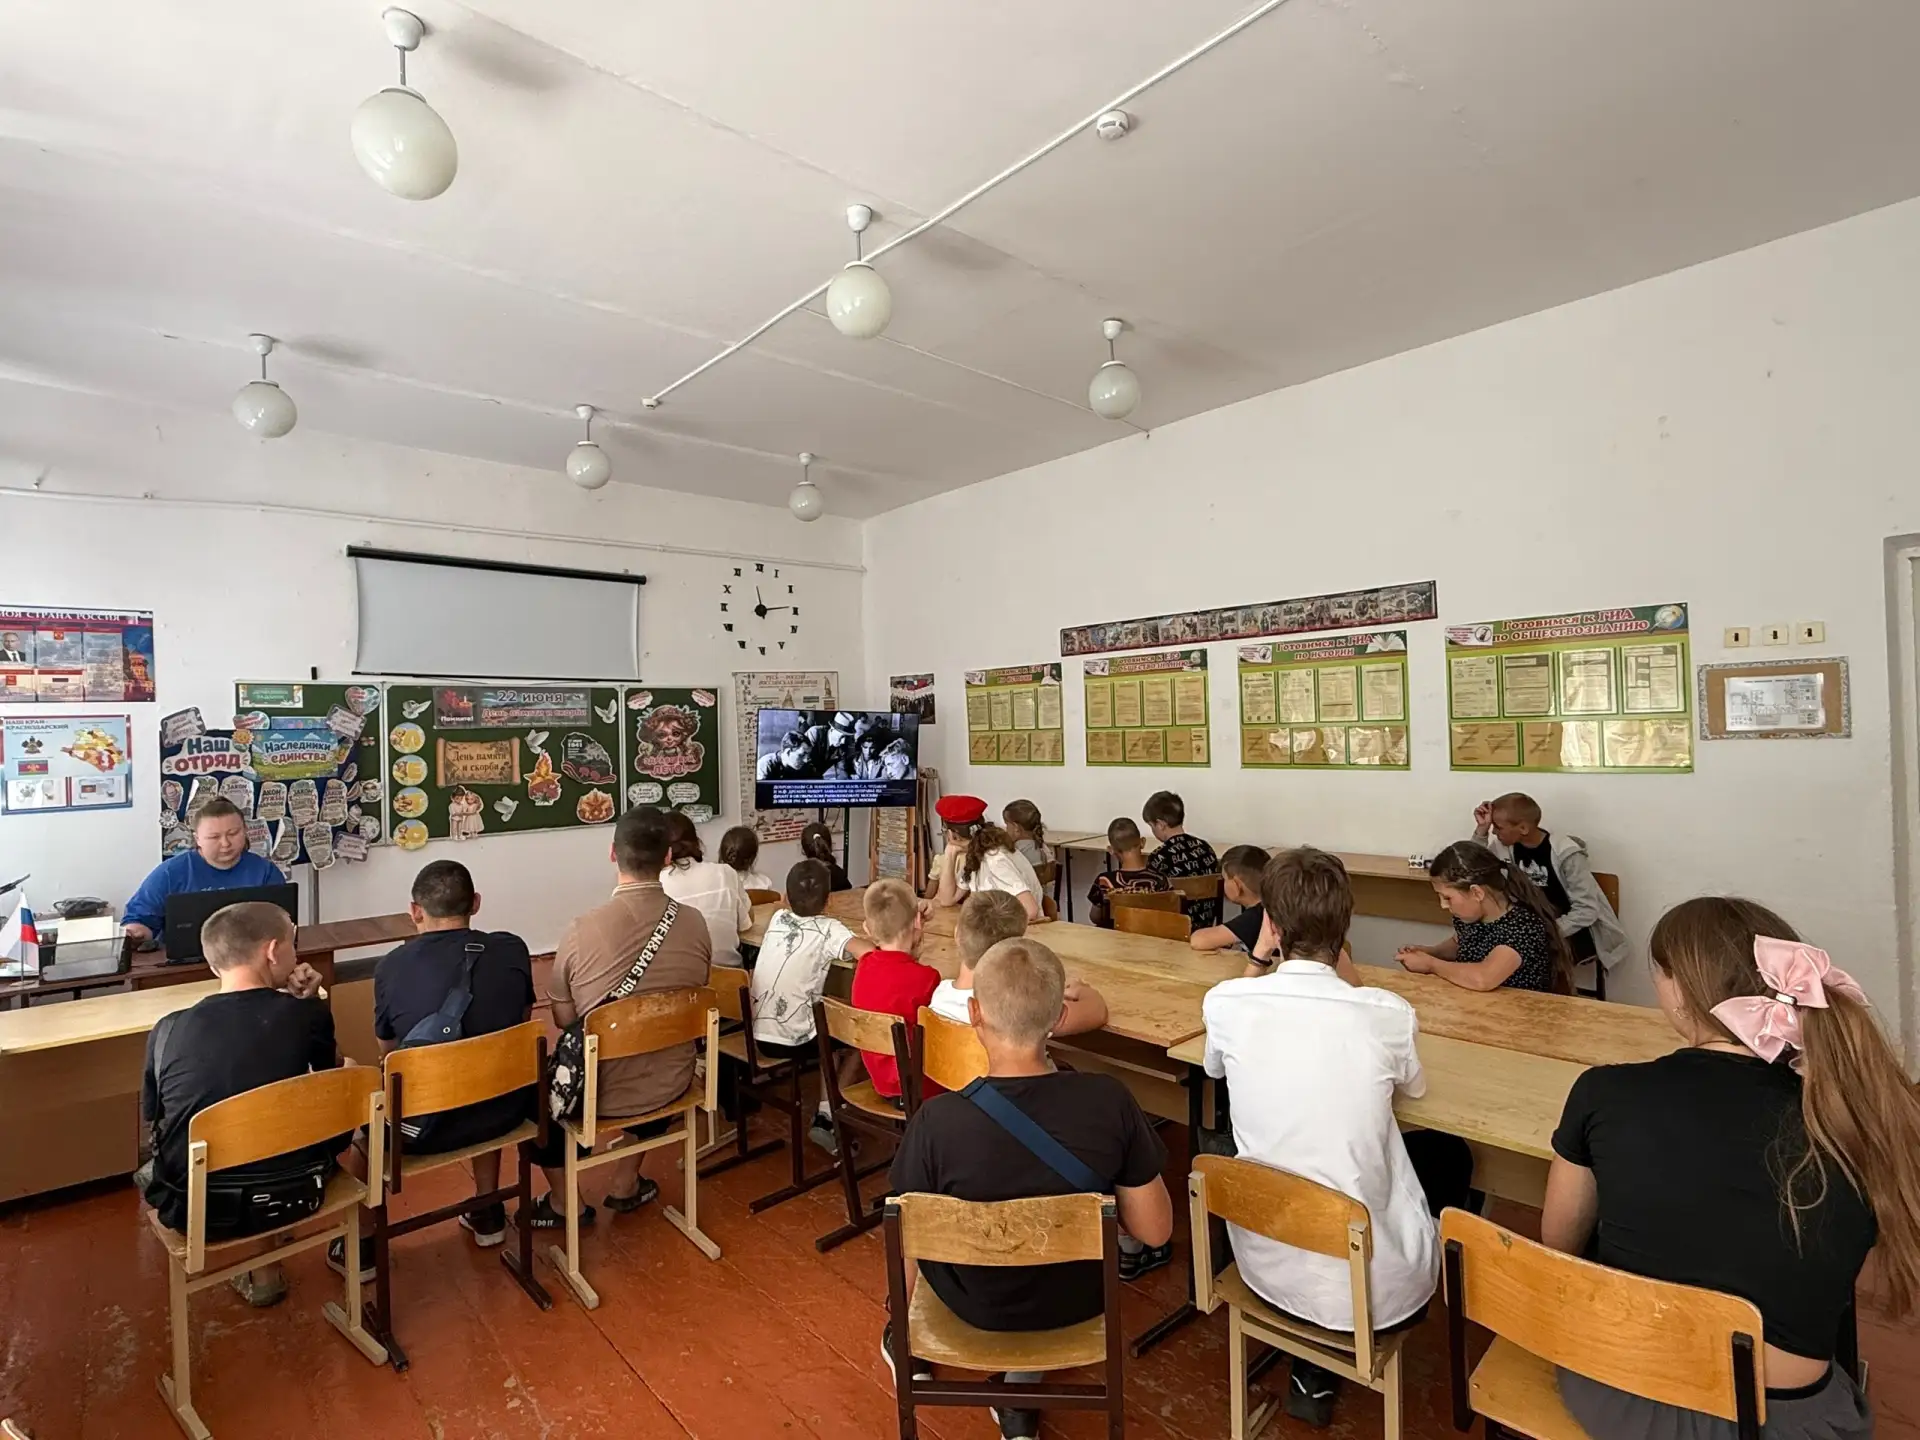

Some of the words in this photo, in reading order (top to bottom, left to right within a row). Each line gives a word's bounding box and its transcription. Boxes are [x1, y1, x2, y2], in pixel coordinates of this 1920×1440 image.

[774, 569, 779, 578] I
[723, 585, 731, 594] X
[27, 612, 72, 620] СТРАНА
[76, 613, 120, 621] РОССИЯ
[1598, 609, 1635, 621] ГИА
[1512, 621, 1649, 640] ОБЩЕСТВОЗНАНИЮ
[778, 641, 785, 649] V
[1348, 634, 1375, 646] ГИА
[497, 690, 518, 702] 22
[522, 692, 564, 703] июня
[187, 738, 231, 756] Наш
[264, 741, 331, 754] Наследники
[270, 752, 328, 764] единства
[452, 751, 474, 762] День
[174, 753, 242, 773] отряд
[470, 761, 499, 772] скорби
[1171, 853, 1188, 865] BLA
